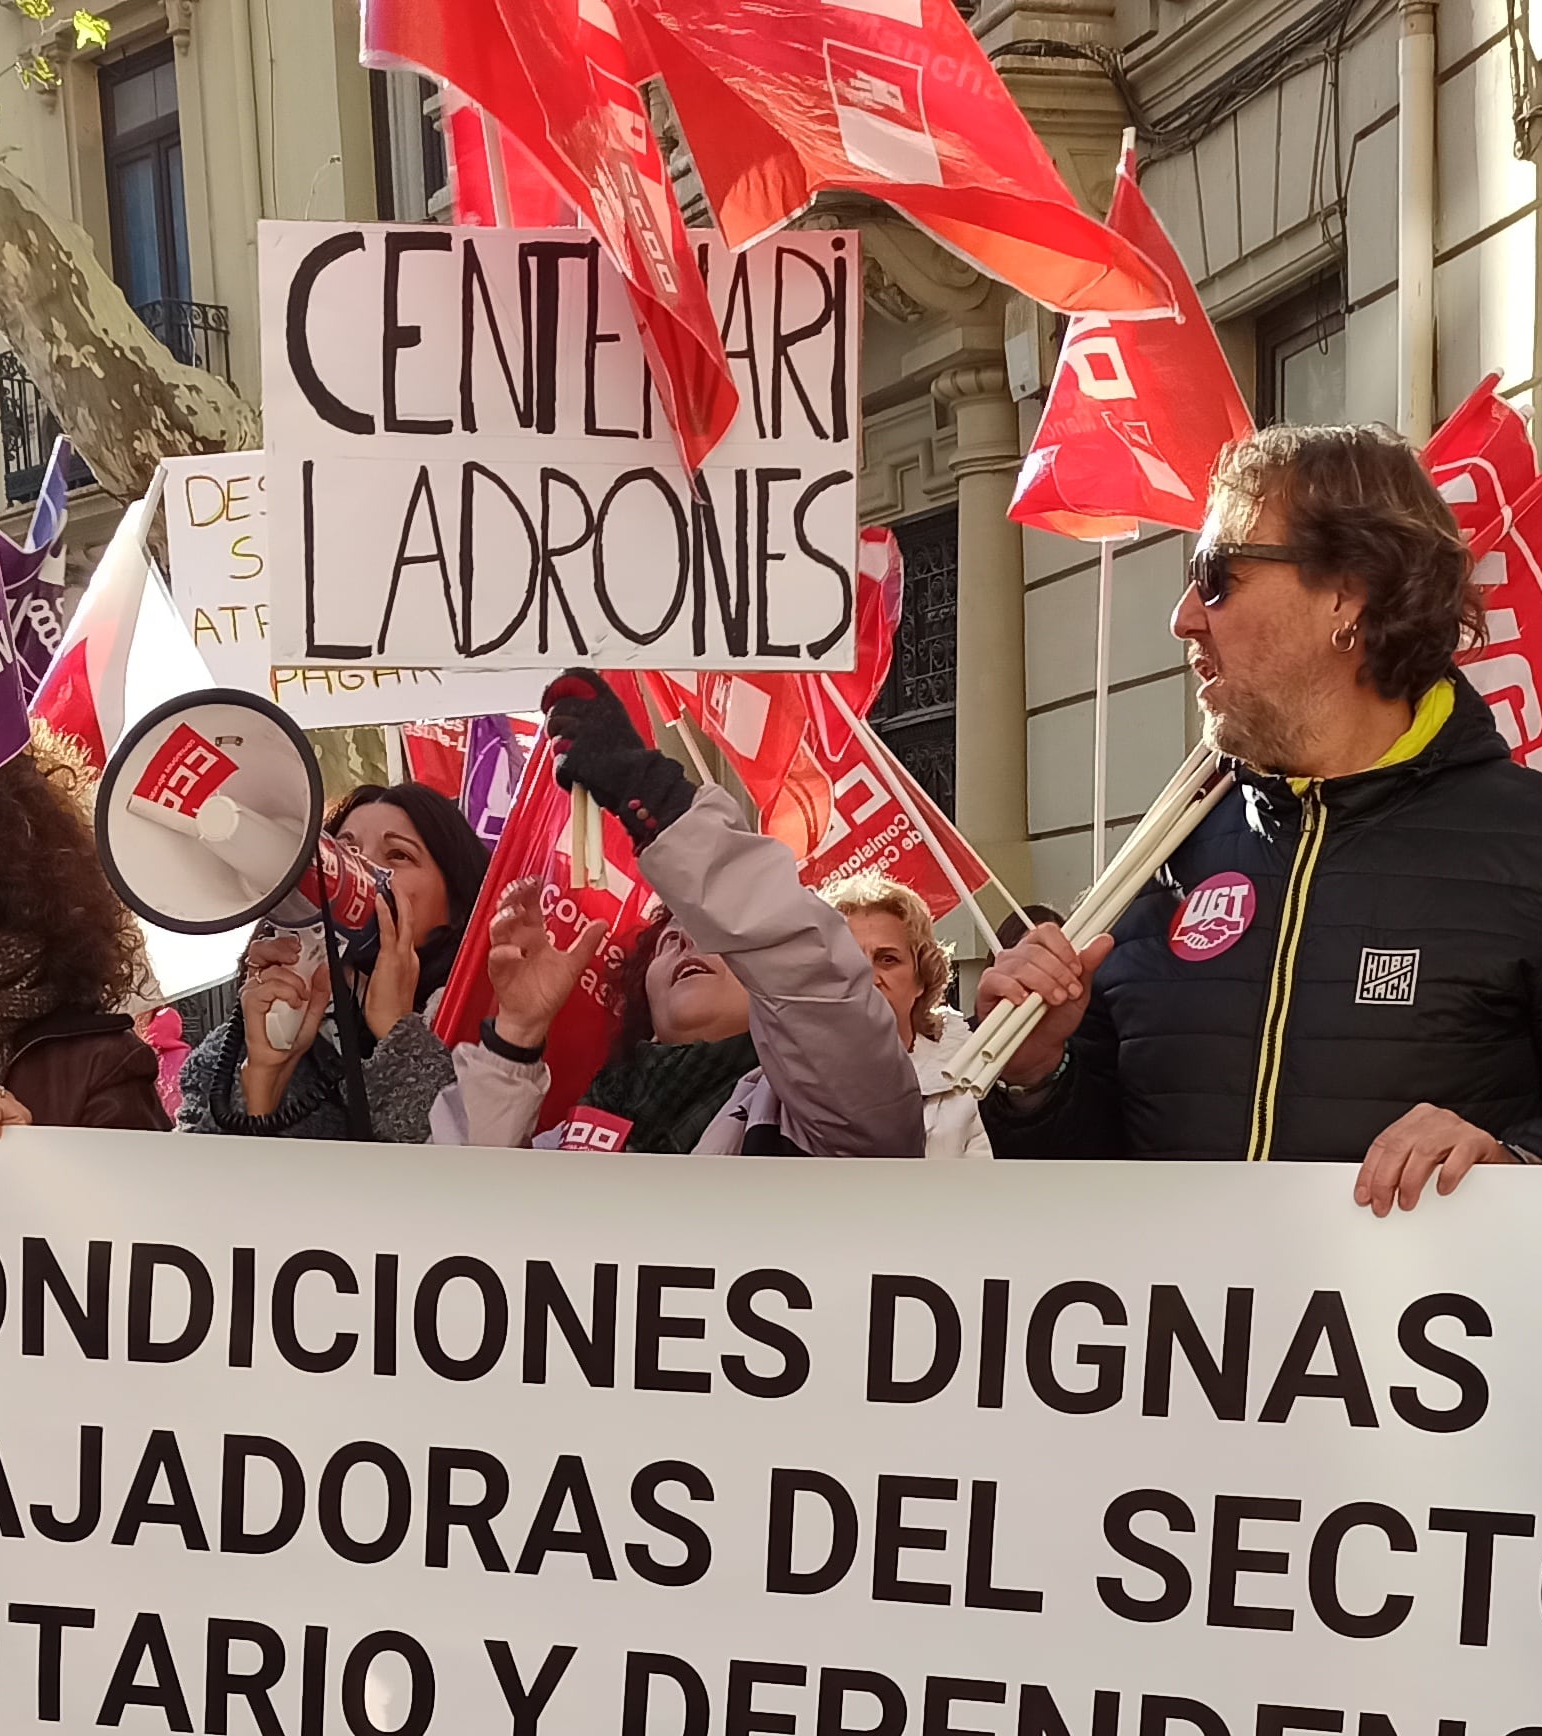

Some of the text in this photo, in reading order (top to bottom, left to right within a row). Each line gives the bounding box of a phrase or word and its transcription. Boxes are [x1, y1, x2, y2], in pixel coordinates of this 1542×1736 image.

[302, 460, 856, 660] LADRONES
[1182, 884, 1250, 927] UGT
[1362, 970, 1412, 1000] JACK
[865, 1273, 1493, 1433] DIGNAS
[765, 1467, 1044, 1614] DEL
